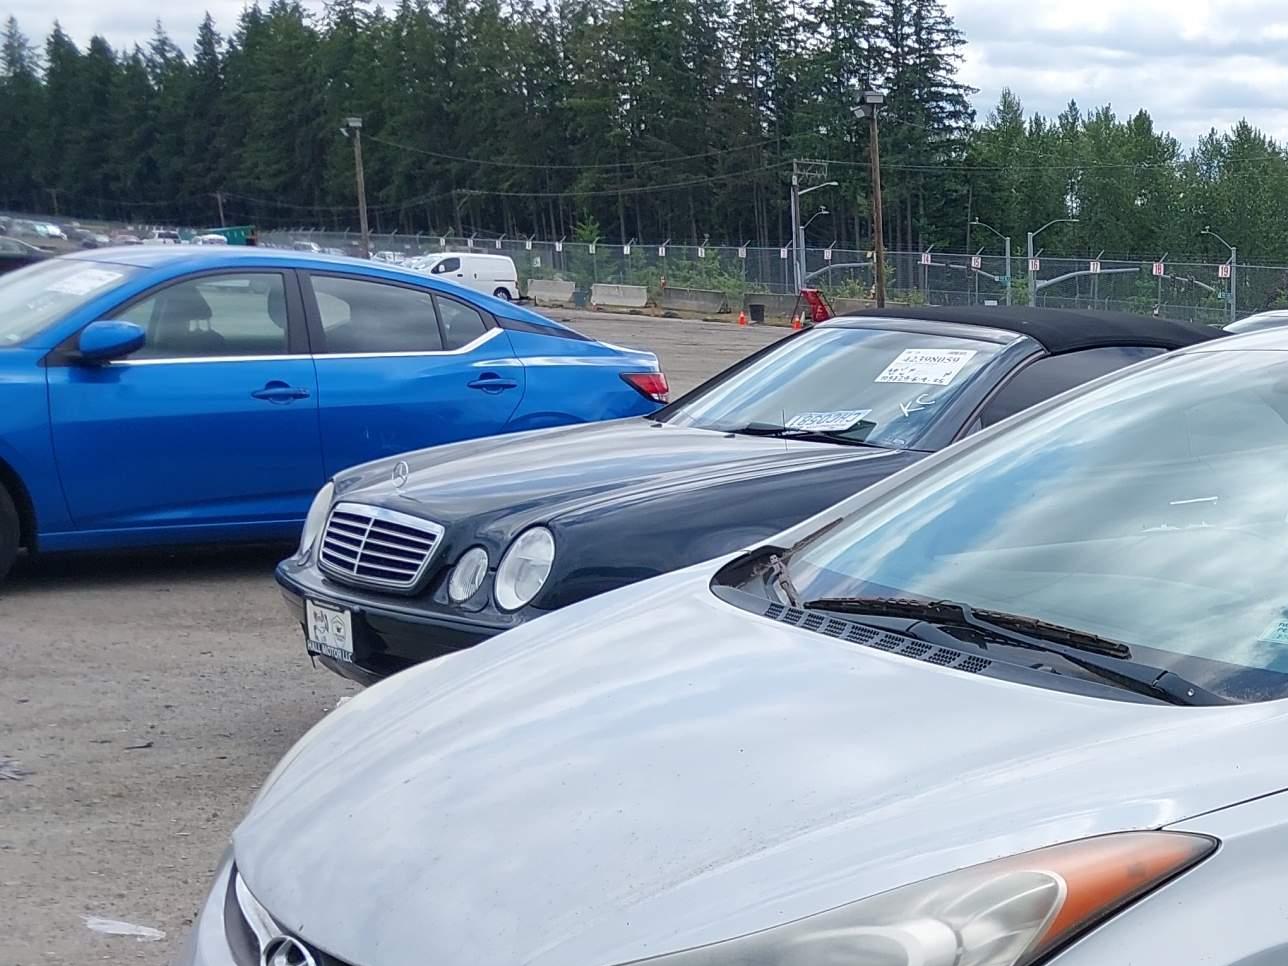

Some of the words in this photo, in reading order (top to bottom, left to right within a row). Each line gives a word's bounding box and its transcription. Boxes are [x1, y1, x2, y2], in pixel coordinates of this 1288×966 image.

[973, 257, 980, 268] 15
[1030, 260, 1038, 270] 16
[1092, 262, 1099, 273] 17
[1154, 264, 1162, 275] 18
[1220, 266, 1229, 277] 19
[322, 644, 342, 660] MOTOR
[342, 650, 353, 663] LLC
